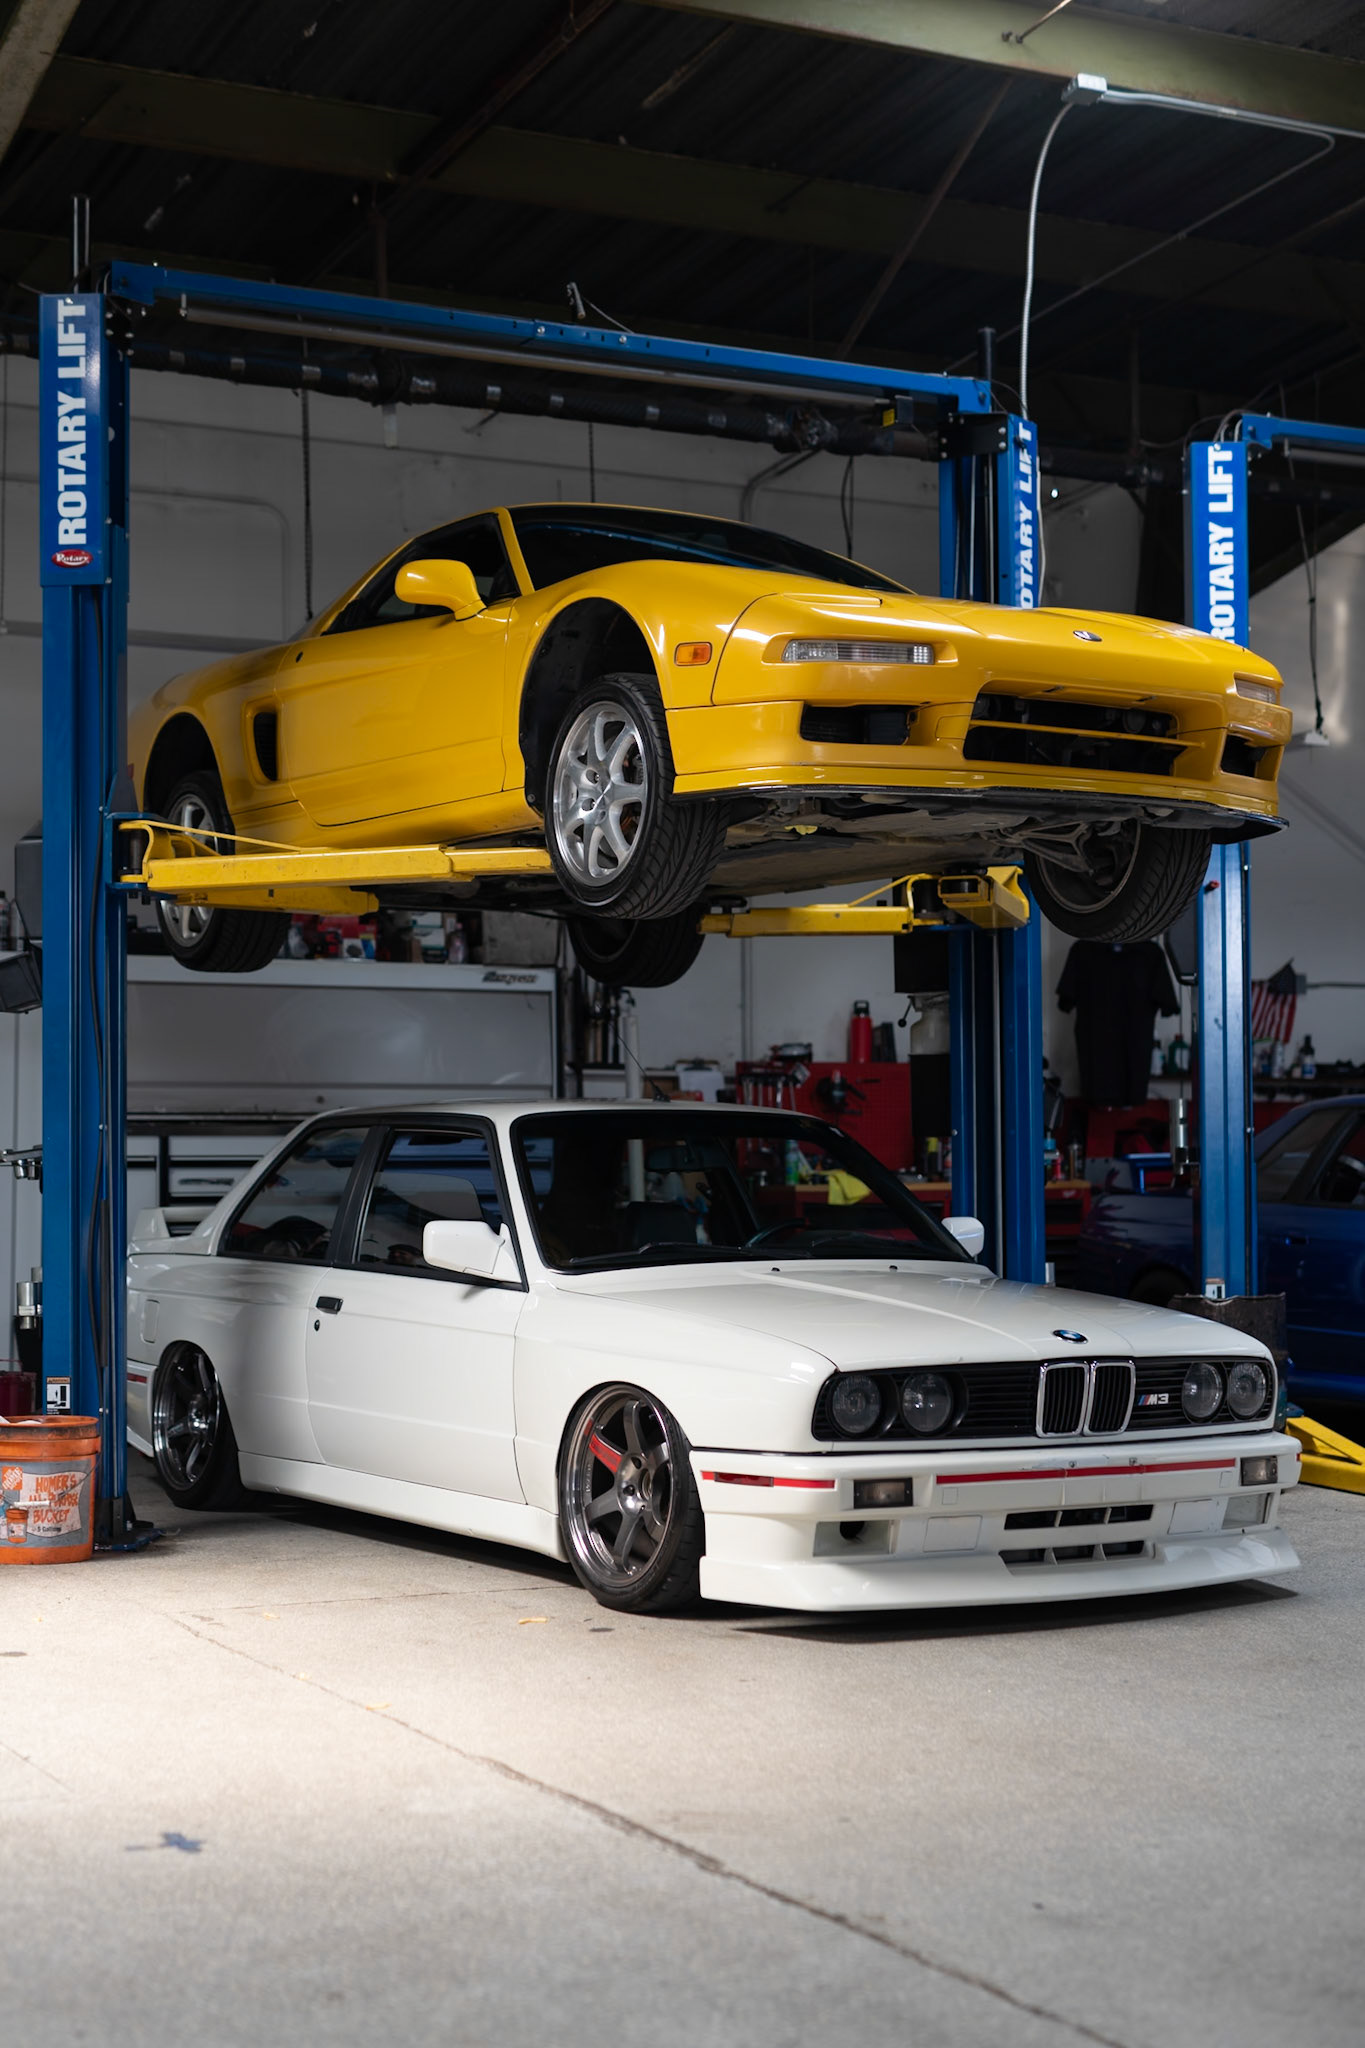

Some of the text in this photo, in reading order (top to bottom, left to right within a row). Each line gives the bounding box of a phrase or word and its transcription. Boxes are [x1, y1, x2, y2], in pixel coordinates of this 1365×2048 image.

[57, 299, 87, 545] ROTARY LIFT
[1208, 445, 1234, 513] LIFT
[1020, 501, 1034, 609] OTARY
[1146, 1393, 1169, 1406] M3
[35, 1474, 77, 1494] HOMER'S
[33, 1508, 70, 1524] BUCKET
